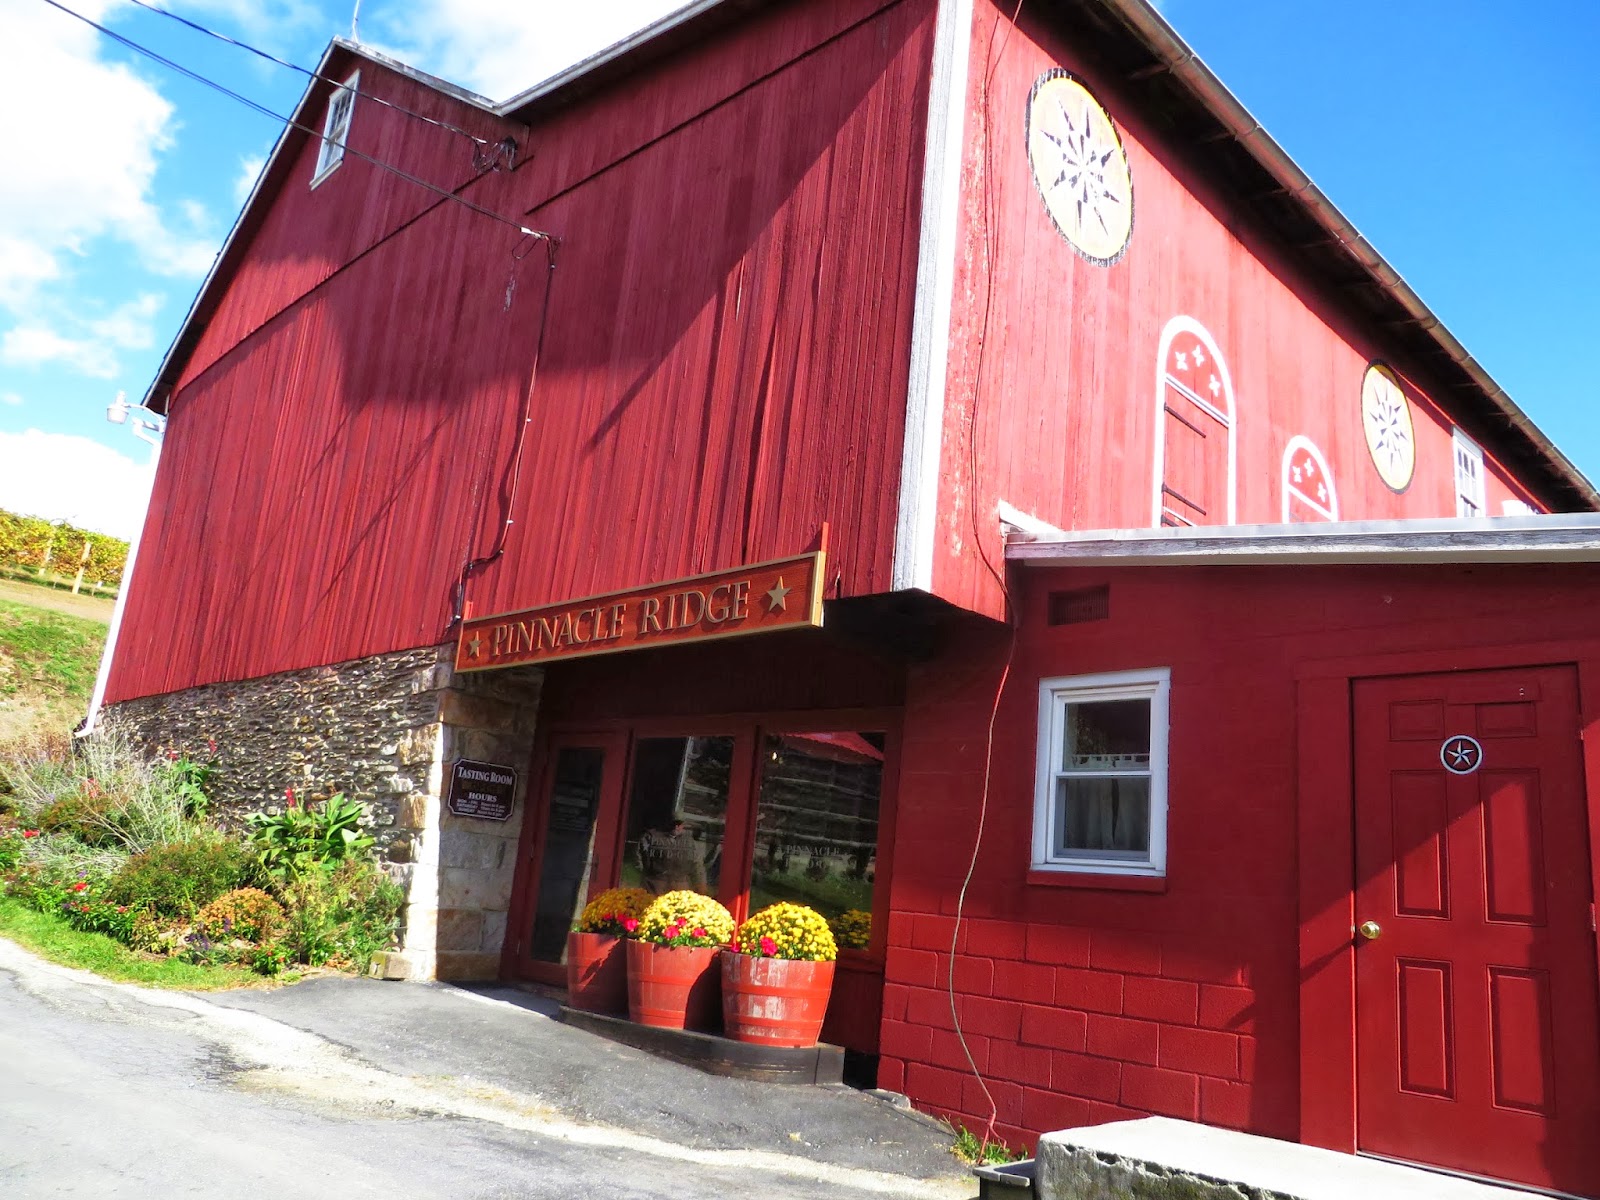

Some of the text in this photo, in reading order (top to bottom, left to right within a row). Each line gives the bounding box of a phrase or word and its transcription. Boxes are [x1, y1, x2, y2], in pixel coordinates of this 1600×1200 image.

[492, 581, 750, 656] PINNACLE RIDGE
[458, 767, 513, 785] TASTING ROOM
[468, 792, 497, 802] HOURS
